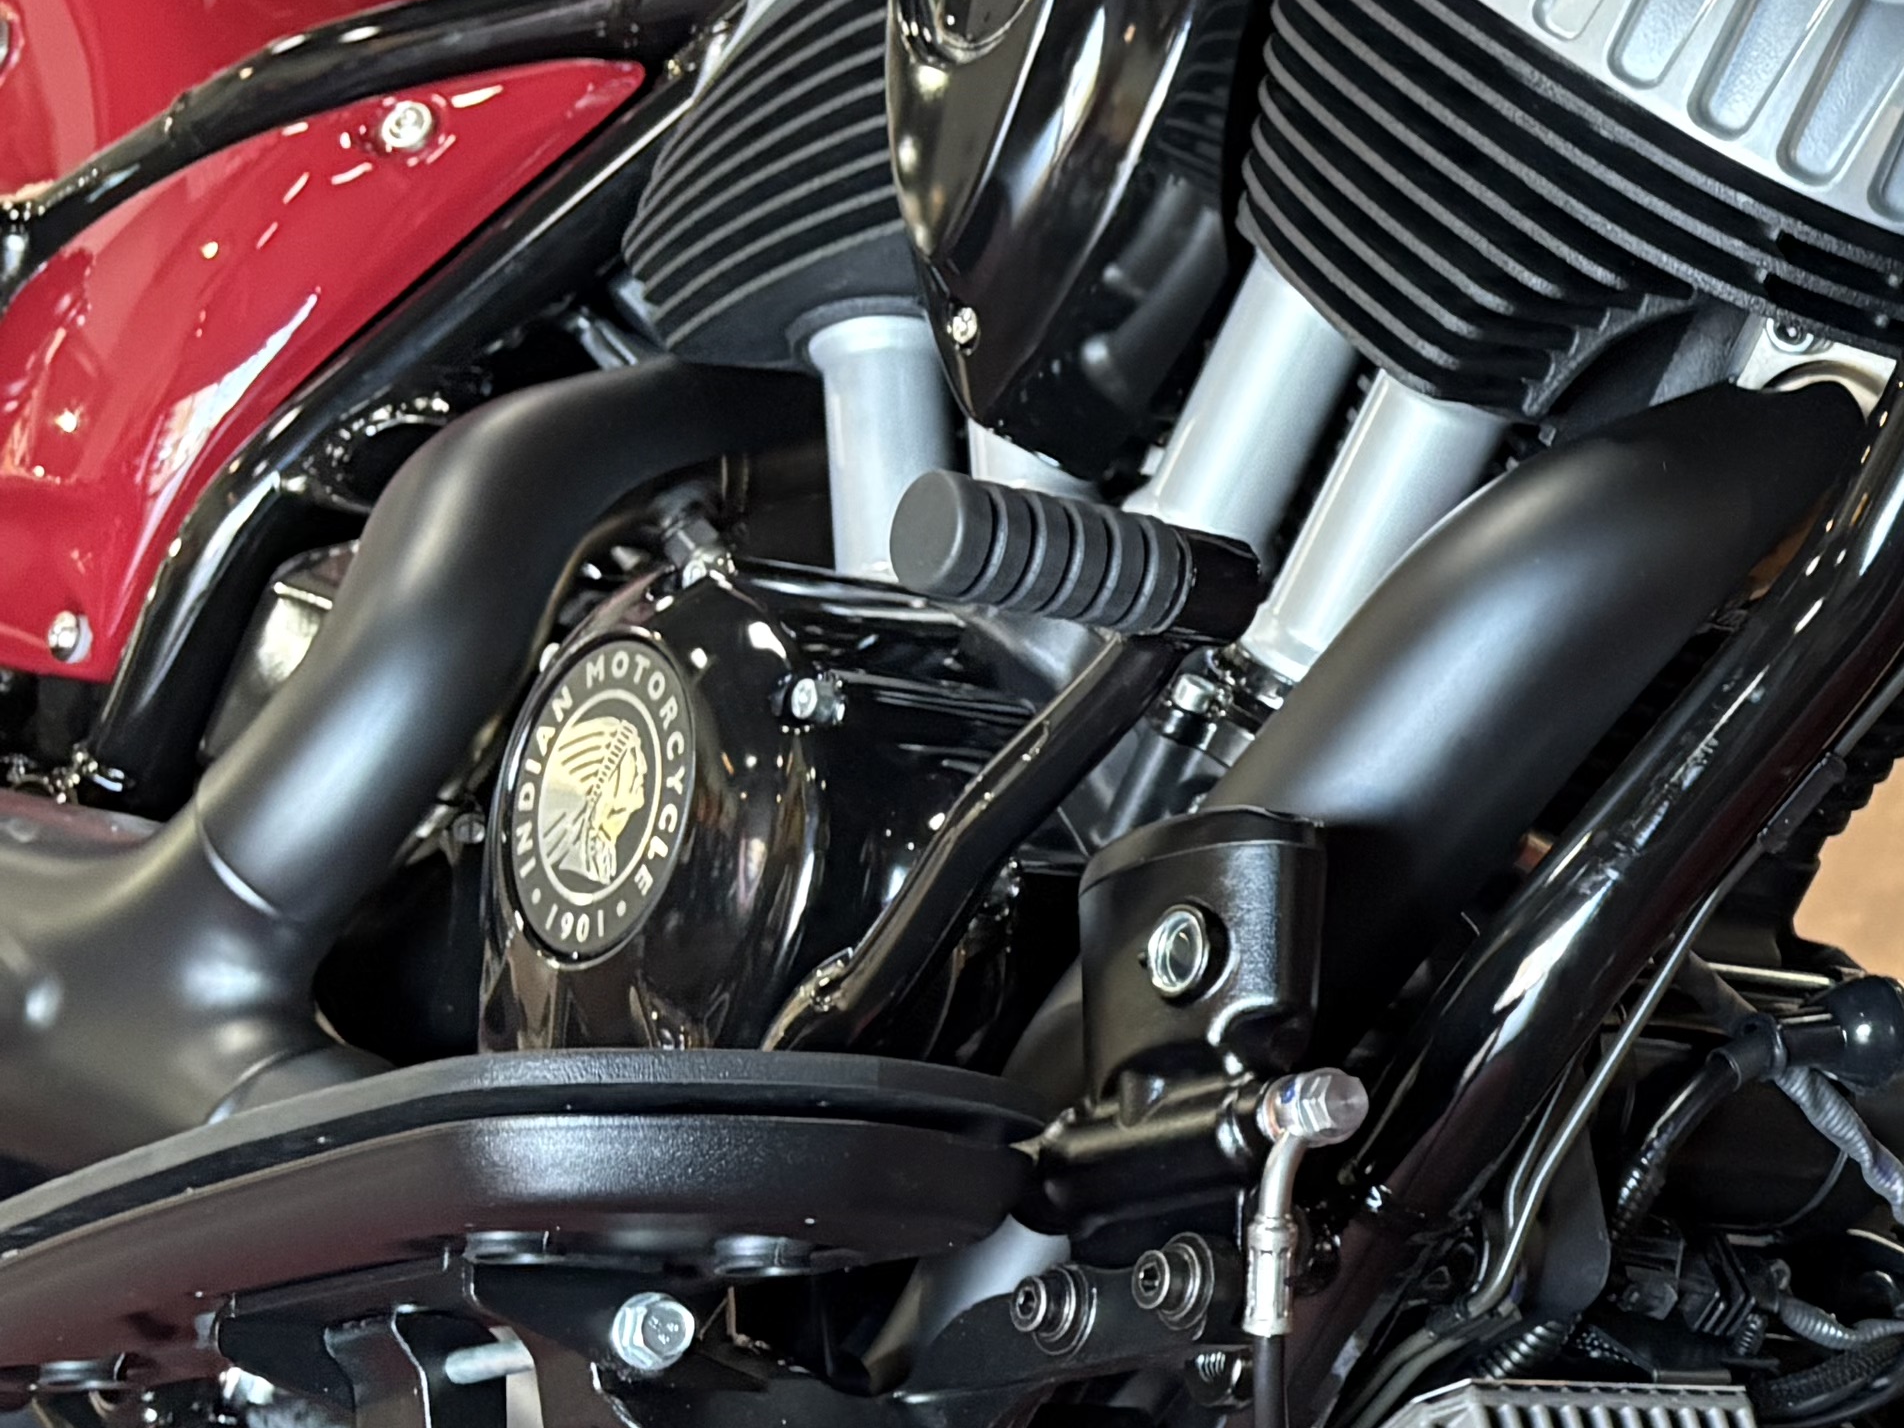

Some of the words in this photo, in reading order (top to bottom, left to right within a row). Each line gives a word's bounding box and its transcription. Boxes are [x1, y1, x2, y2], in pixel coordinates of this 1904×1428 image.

[516, 685, 574, 879] INDIAN
[586, 650, 687, 896] MOTORCYCLE
[545, 902, 606, 944] 1901
